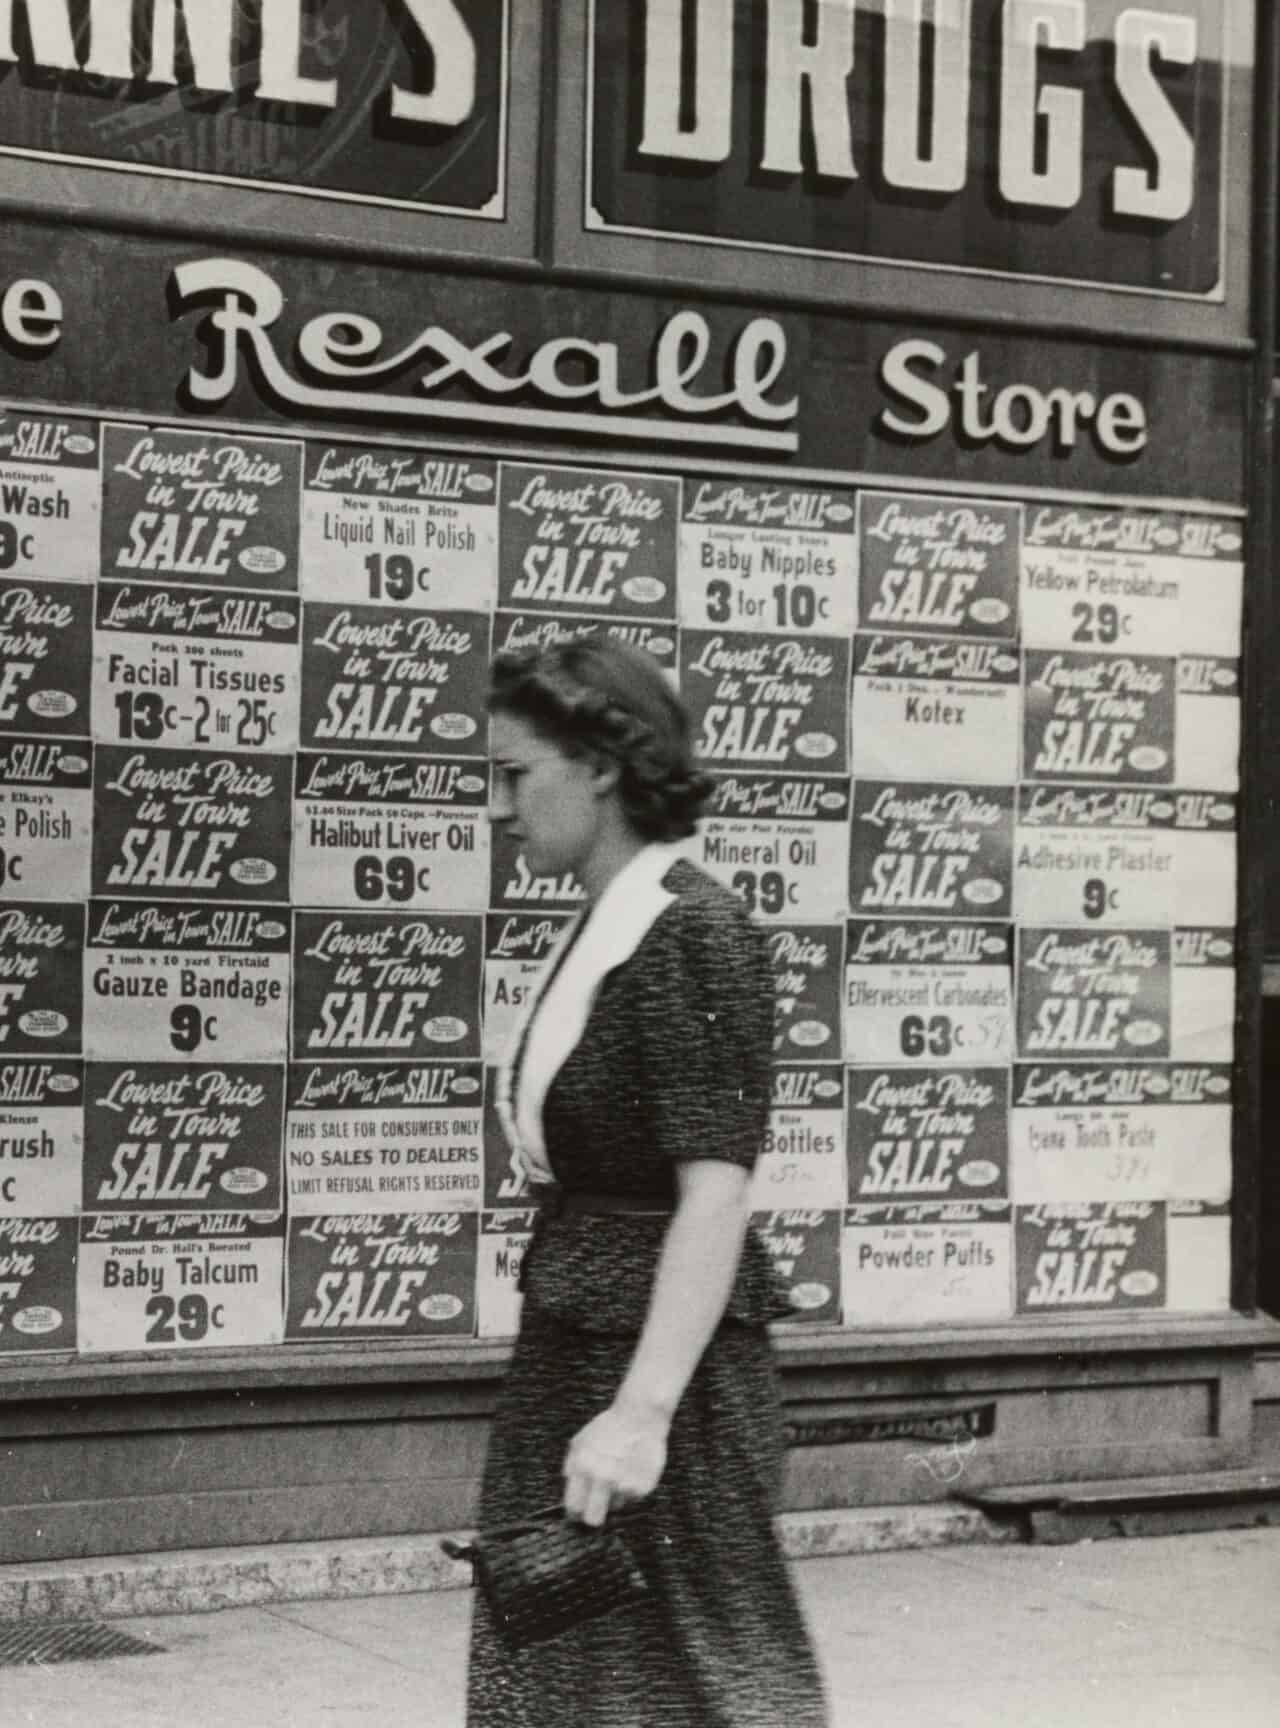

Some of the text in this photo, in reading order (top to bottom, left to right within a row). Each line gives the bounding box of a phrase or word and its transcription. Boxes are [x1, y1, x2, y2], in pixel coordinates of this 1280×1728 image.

[639, 0, 1197, 221] DRUGS
[173, 257, 799, 451] Rexall
[881, 338, 1147, 453] Store
[11, 422, 69, 460] SALE
[1, 483, 69, 519] Wash
[509, 475, 662, 519] Lowest Price
[324, 512, 475, 551] Liquid Nail Polish
[538, 513, 640, 547] in Town
[511, 546, 629, 604] SALE
[701, 542, 836, 580] Baby Nipples
[1025, 565, 1080, 590] Yellow
[1, 587, 73, 627] Price
[706, 579, 731, 623] 3
[738, 590, 766, 616] for
[109, 654, 285, 694] Facial Tissues
[689, 637, 833, 677] Lowest Price
[716, 674, 813, 703] in Town
[216, 709, 231, 733] for
[905, 697, 965, 725] Kotex
[696, 705, 802, 761] SALE
[4, 745, 62, 781] SALE
[106, 754, 274, 797] Lowest Price
[15, 808, 71, 839] Polish
[137, 793, 251, 826] in Town
[310, 818, 474, 851] Halibut Liver Oil
[704, 836, 817, 865] Mineral Oil
[107, 828, 238, 888] SALE
[1018, 844, 1100, 872] Adhesive
[304, 921, 465, 961] Lowest Price
[93, 968, 281, 1006] Gauze Bandage
[334, 958, 443, 990] in Town
[307, 992, 429, 1048] SALE
[856, 1074, 994, 1112] Lowest Price
[291, 1119, 480, 1139] THIS SALE FOR CONSUMERS ONLY
[882, 1108, 975, 1137] in Town
[290, 1147, 479, 1166] NO SALES TO DEALERS
[860, 1141, 964, 1195] SALE
[291, 1174, 480, 1195] LIMIT REFUSAL RIGHTS RESERVED
[111, 1246, 145, 1256] Pound
[859, 1241, 994, 1269] Powder Puffs
[104, 1257, 258, 1293] Baby Talcum
